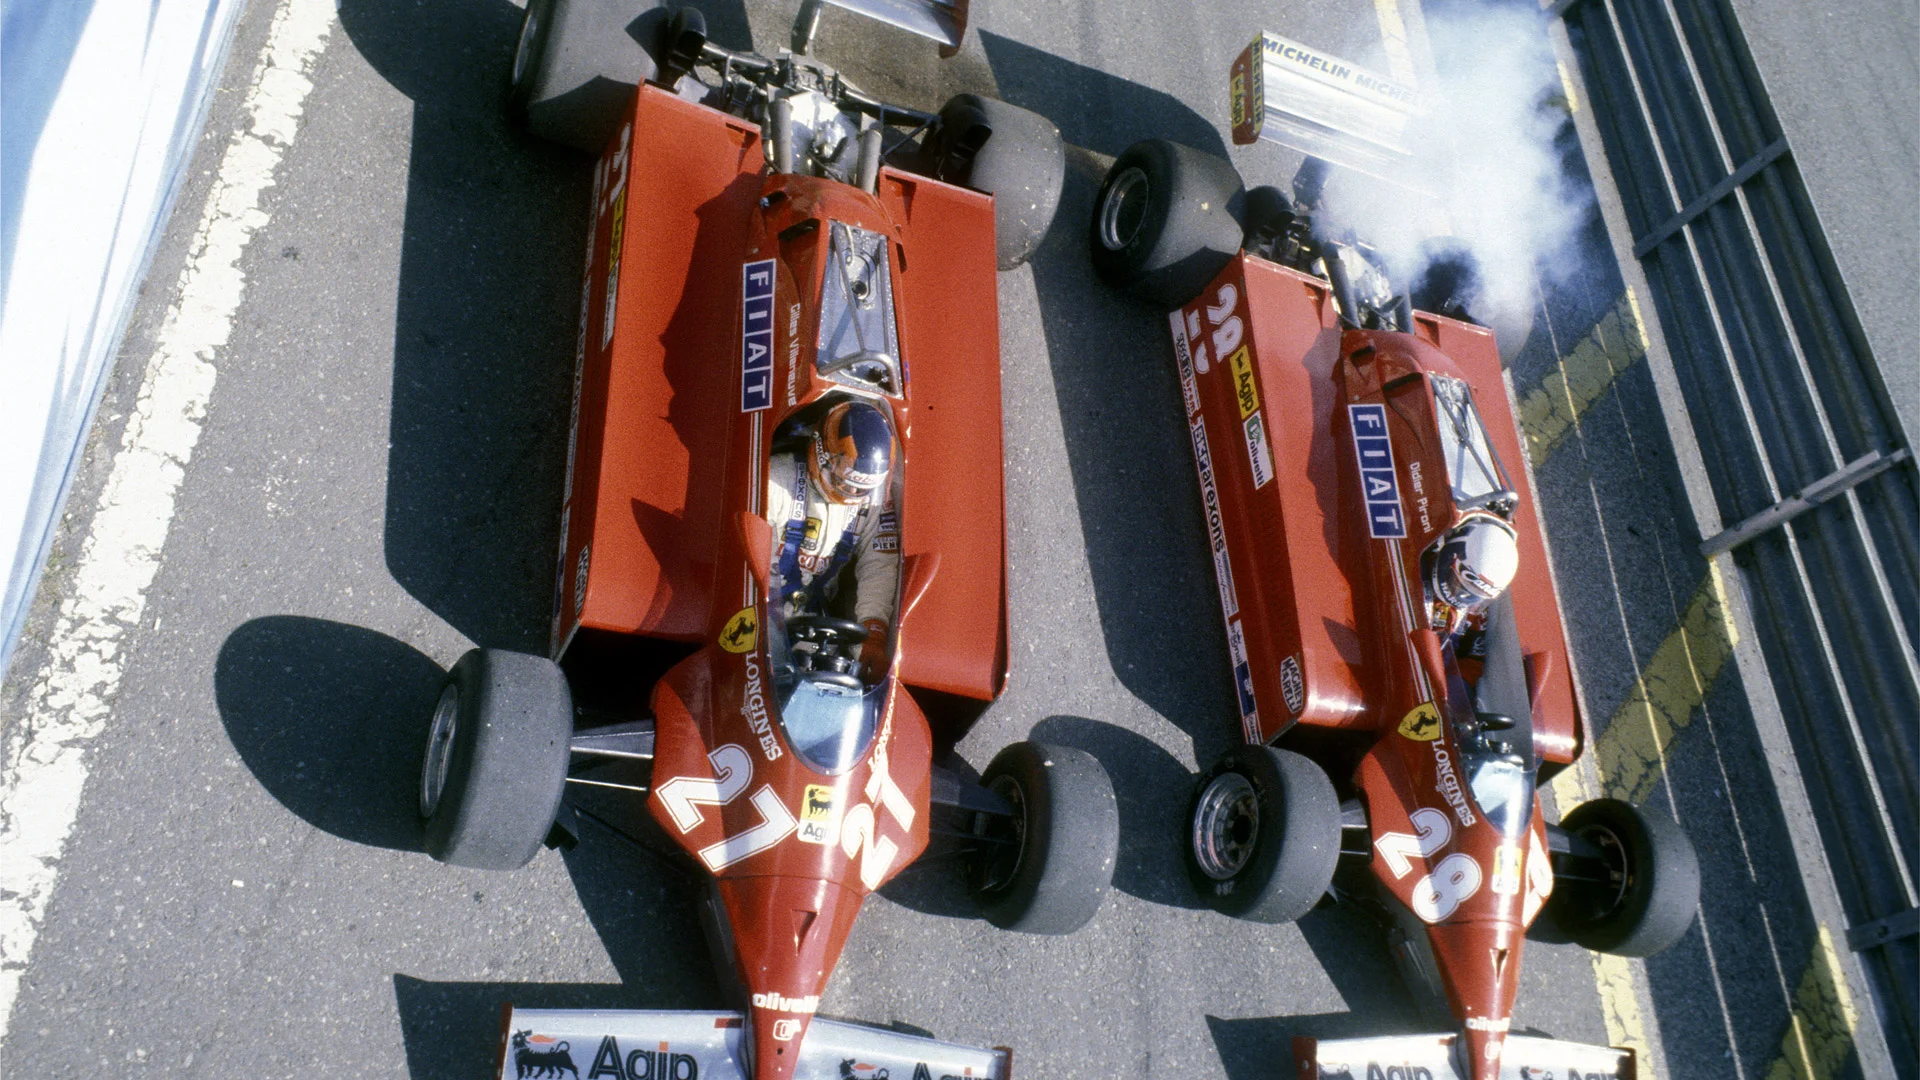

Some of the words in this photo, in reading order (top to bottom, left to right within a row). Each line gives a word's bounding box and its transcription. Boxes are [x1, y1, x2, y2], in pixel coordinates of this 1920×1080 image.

[1251, 41, 1263, 125] MICHELIN
[1262, 37, 1351, 80] MICHELIN
[748, 271, 769, 399] FIAT
[790, 303, 801, 337] Gilles
[787, 338, 800, 407] Villeneuve
[1239, 370, 1255, 411] Agip
[794, 463, 806, 518] arexons
[1249, 441, 1265, 486] olivetti
[1357, 414, 1399, 529] FIAT
[1409, 462, 1423, 495] Didier
[1417, 497, 1434, 533] Pironi
[1202, 470, 1224, 553] arexons
[745, 651, 783, 761] LONGINES
[655, 743, 800, 873] 27
[841, 748, 916, 891] 27
[1432, 739, 1477, 828] LONGINES
[1374, 807, 1483, 924] 28
